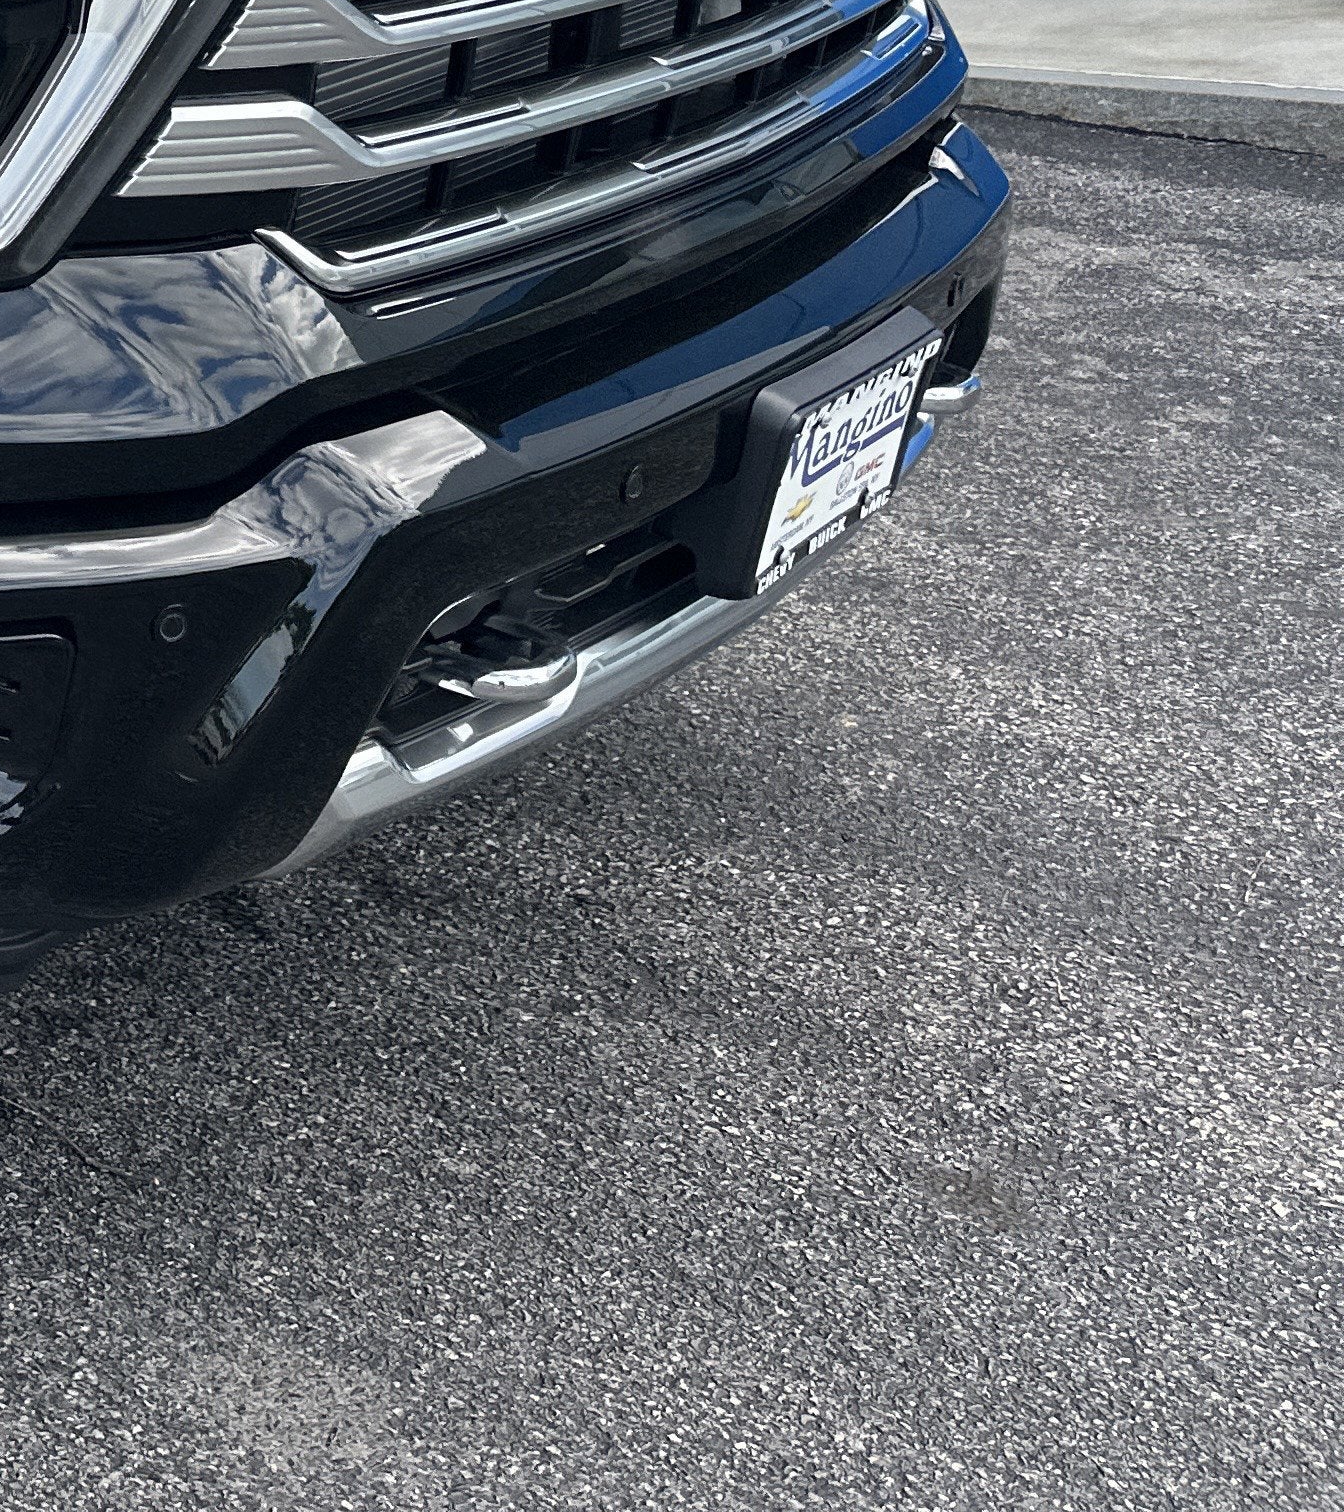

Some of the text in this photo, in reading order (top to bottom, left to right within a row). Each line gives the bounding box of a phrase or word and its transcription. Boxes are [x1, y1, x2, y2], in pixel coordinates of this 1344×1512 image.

[789, 380, 913, 487] Mangino
[854, 452, 886, 481] GMC
[757, 489, 891, 595] CHEVY BUICK GMC
